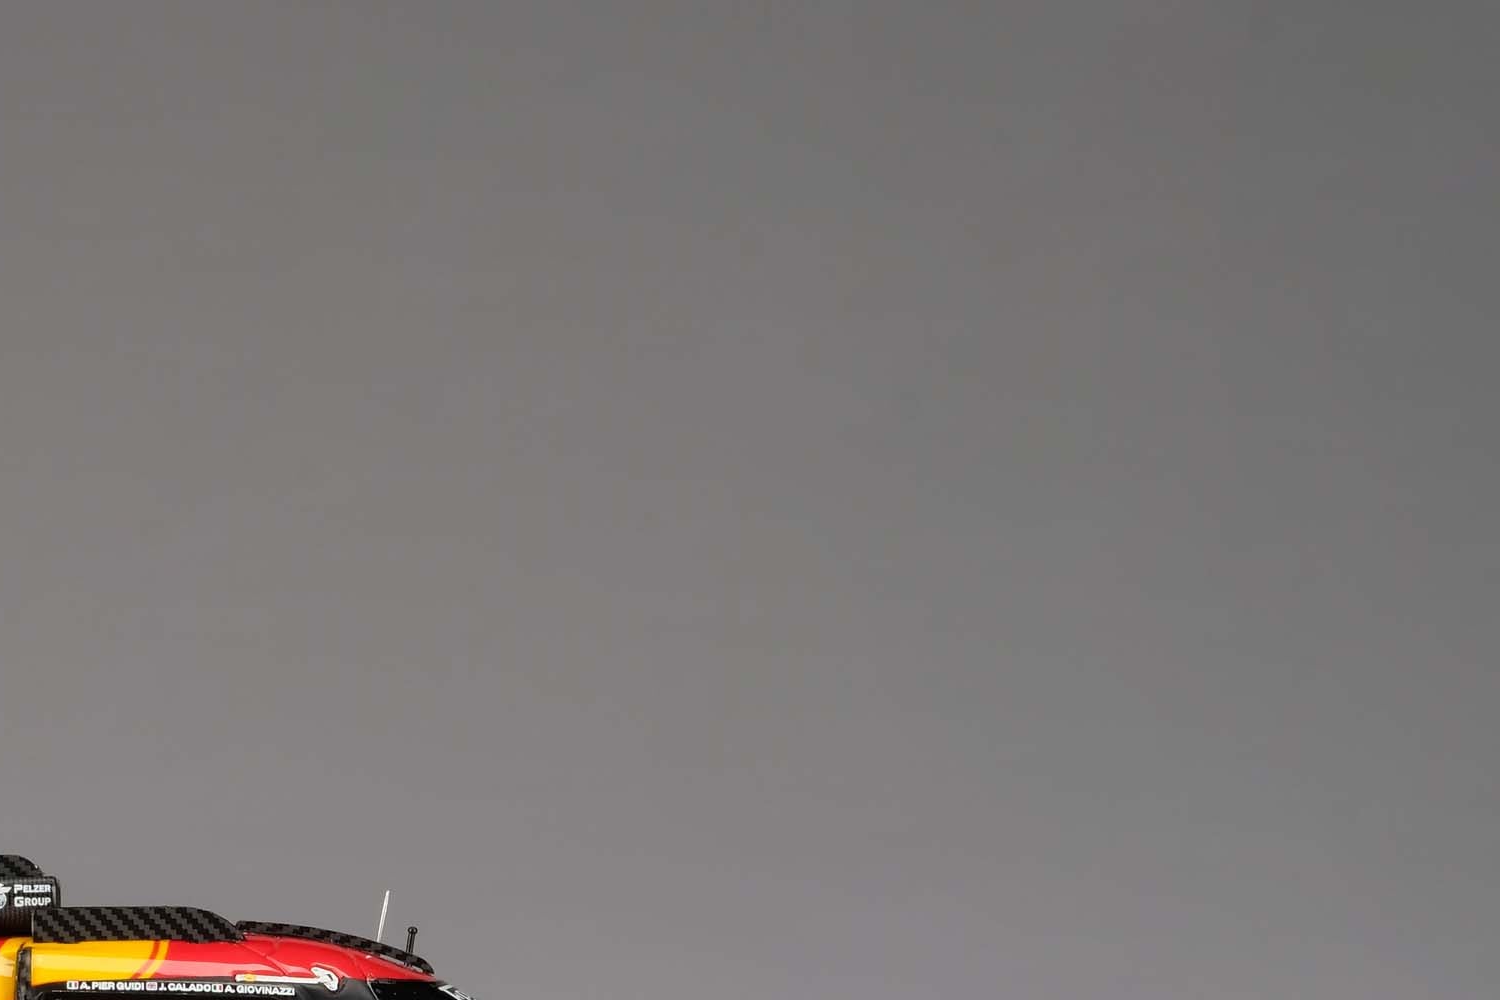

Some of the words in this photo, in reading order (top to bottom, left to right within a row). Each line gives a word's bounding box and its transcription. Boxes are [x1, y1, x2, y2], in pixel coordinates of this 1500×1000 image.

[13, 884, 52, 893] PELZER
[13, 896, 52, 907] GROUP
[116, 981, 145, 991] GUIDI
[168, 982, 213, 992] CALADO
[237, 985, 296, 996] GIOVINAZZI
